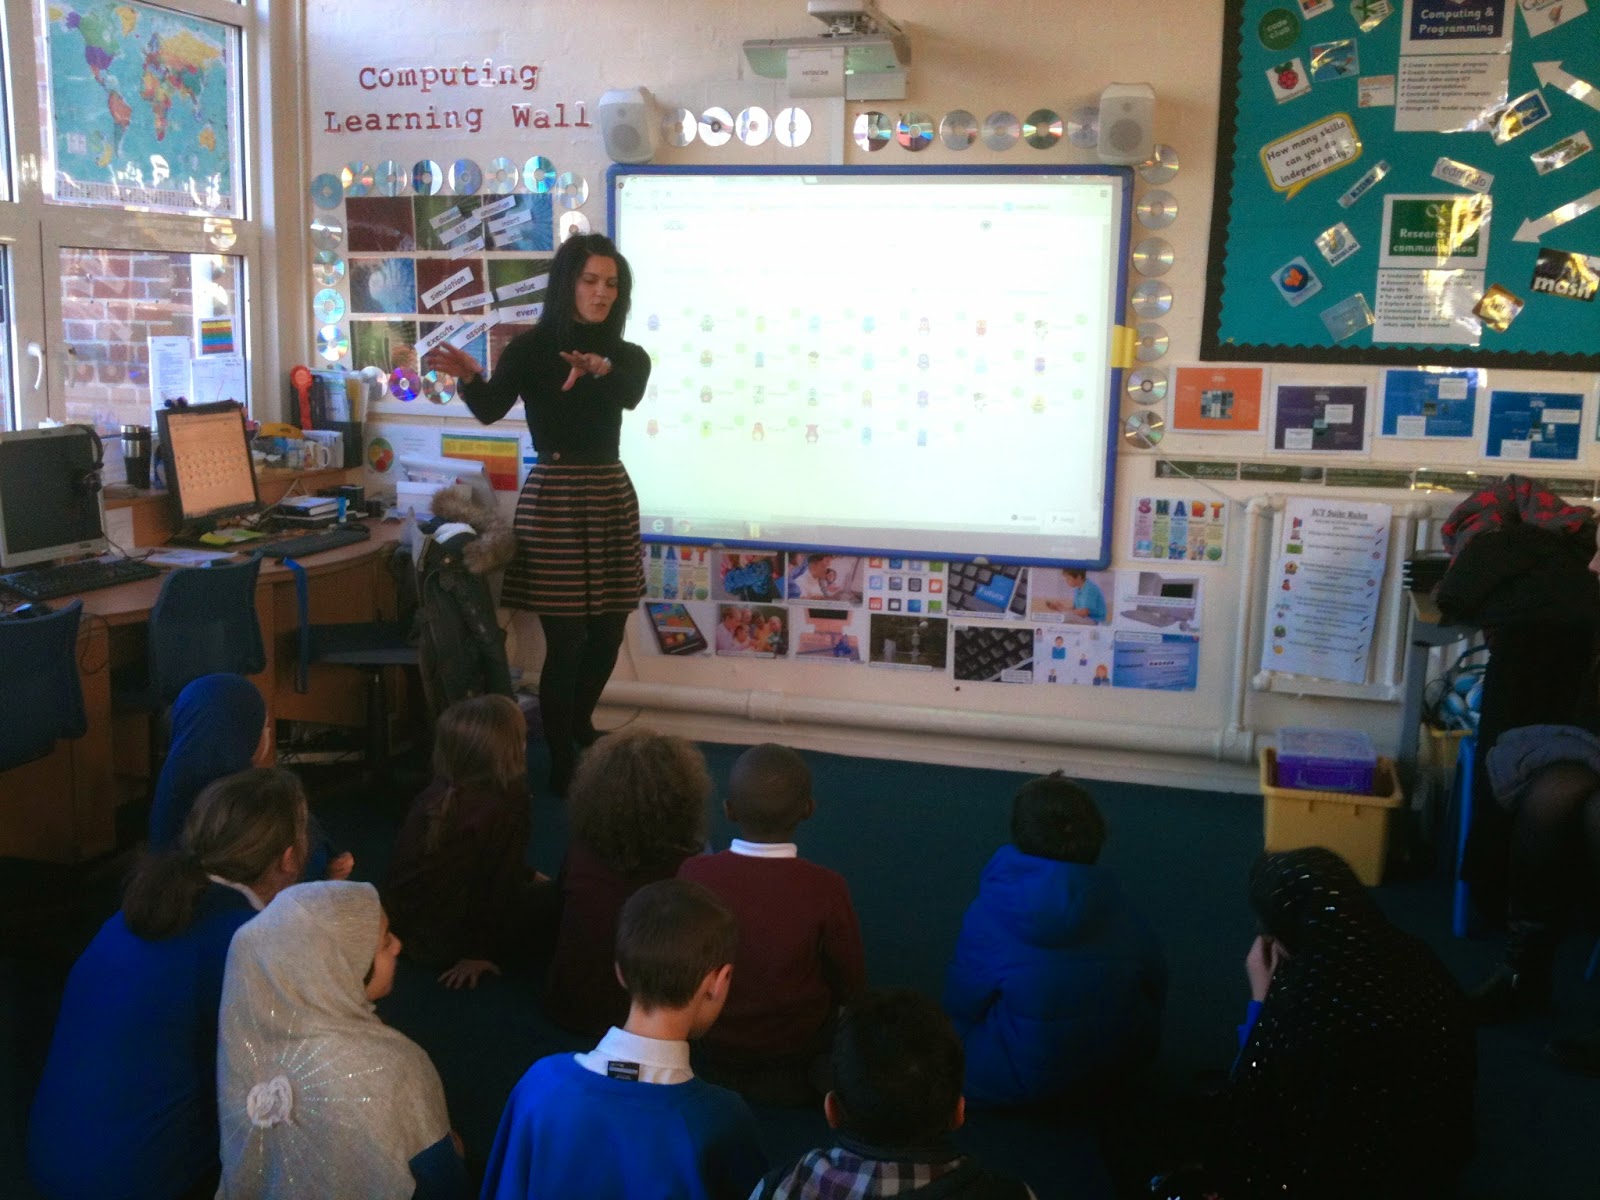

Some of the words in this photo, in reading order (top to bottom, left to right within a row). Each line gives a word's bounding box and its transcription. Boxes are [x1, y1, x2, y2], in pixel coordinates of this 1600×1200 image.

[1420, 9, 1481, 21] Computing
[1485, 6, 1495, 17] &
[1418, 24, 1494, 36] Programming
[359, 60, 540, 93] Computing
[324, 105, 484, 134] Learning
[511, 101, 592, 129] Wall
[1266, 146, 1290, 162] How
[1291, 133, 1319, 152] many
[1319, 120, 1346, 138] skills
[1284, 154, 1303, 168] can
[1303, 147, 1323, 160] you
[430, 275, 466, 301] simulation
[514, 282, 536, 293] value
[1533, 277, 1593, 299] mash
[516, 307, 539, 317] event
[426, 324, 455, 347] execute
[465, 322, 488, 341] assign
[1138, 498, 1225, 519] SMART
[1312, 508, 1326, 517] ICT
